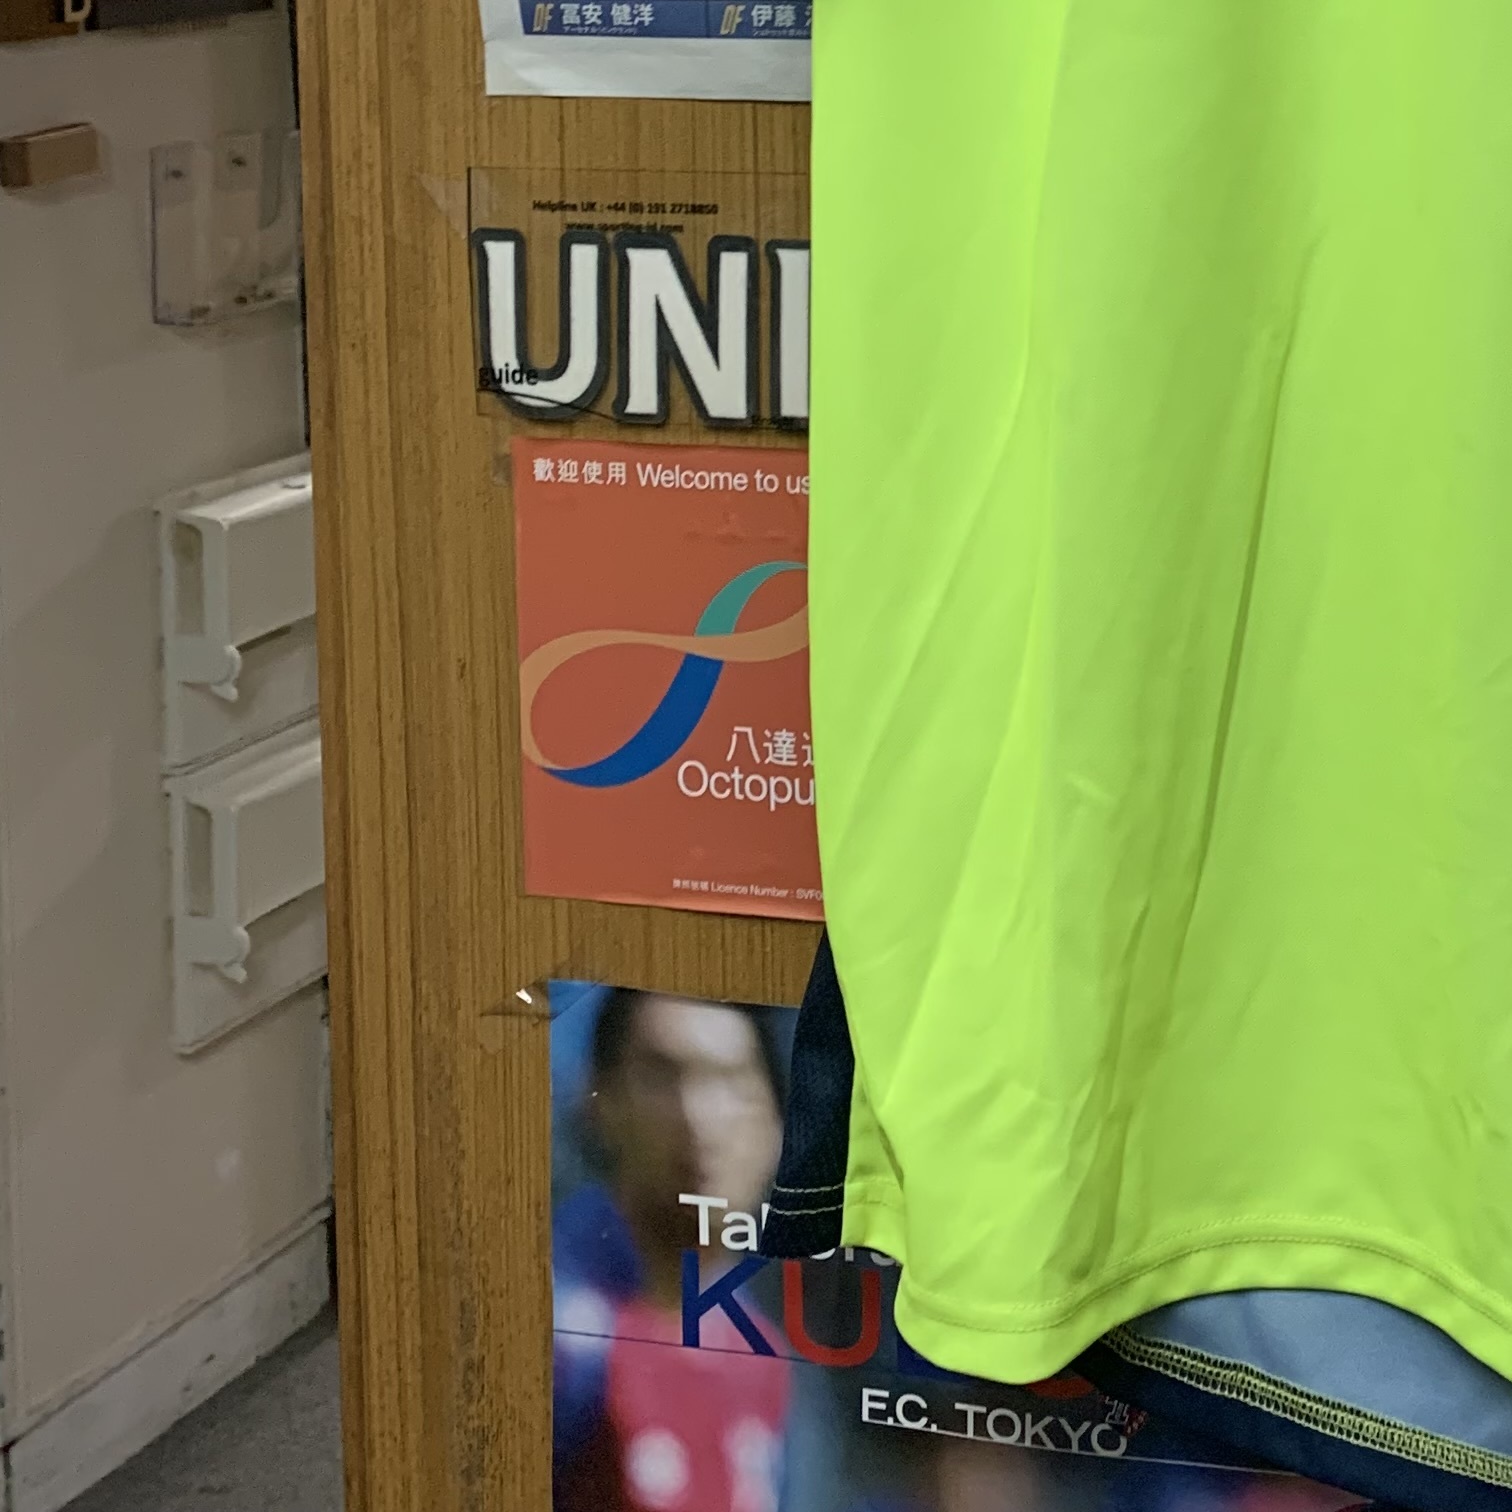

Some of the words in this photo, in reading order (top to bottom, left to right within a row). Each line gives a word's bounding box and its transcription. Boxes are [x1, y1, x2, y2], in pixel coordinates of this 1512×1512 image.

[533, 200, 577, 213] Helpline
[478, 362, 539, 386] guide
[533, 458, 627, 486] 歡迎使用
[636, 462, 748, 491] Welcome
[754, 469, 779, 493] to
[677, 760, 814, 812] Octopu
[711, 883, 748, 896] Licence
[750, 884, 788, 897] Number
[796, 888, 824, 901] SVF0
[862, 1387, 937, 1431] F.C.
[954, 1402, 1128, 1458] TOKYO
